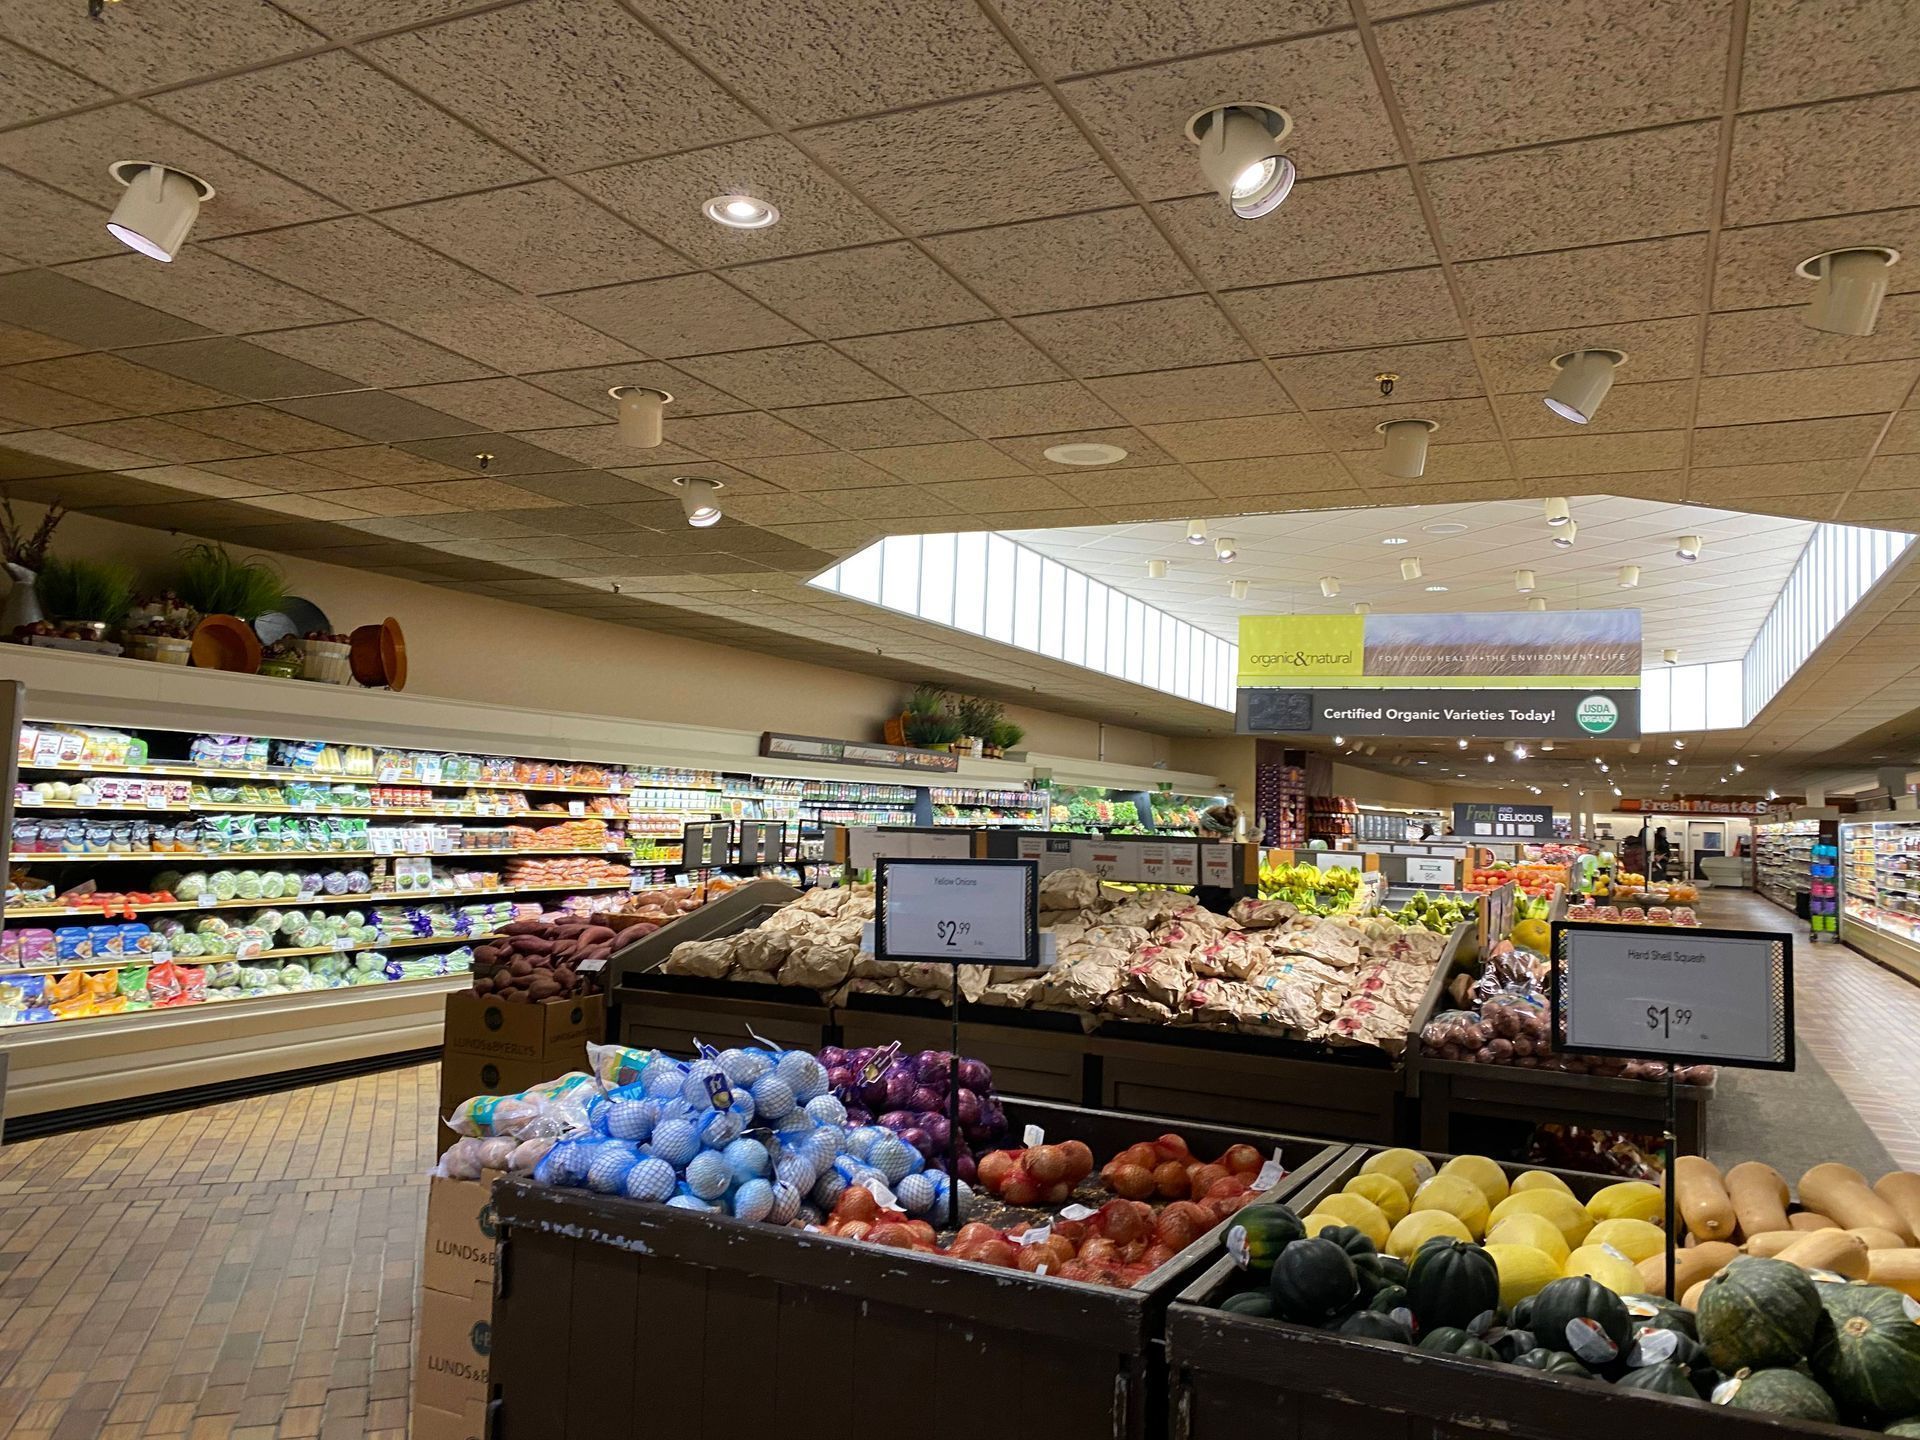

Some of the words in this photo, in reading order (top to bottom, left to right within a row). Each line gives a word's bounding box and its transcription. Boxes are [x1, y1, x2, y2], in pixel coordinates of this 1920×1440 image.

[1250, 651, 1352, 667] organic&natural
[1323, 707, 1382, 719] Certified
[1385, 708, 1439, 722] Organic
[1443, 709, 1505, 721] Varieties
[1508, 709, 1556, 724] Today!
[1583, 704, 1610, 713] USDA
[1465, 805, 1497, 822] Fresh
[1639, 799, 1689, 812] Fresh
[1497, 813, 1544, 823] DELICIOUS
[955, 877, 977, 886] Onions
[937, 920, 971, 946] $2.99
[1627, 949, 1649, 960] Hard
[1650, 950, 1672, 962] Shell
[1674, 952, 1706, 964] Squash
[1646, 1005, 1693, 1039] $1.99
[435, 1239, 495, 1266] LUNDS&B
[427, 1355, 489, 1384] LUNDS&B
